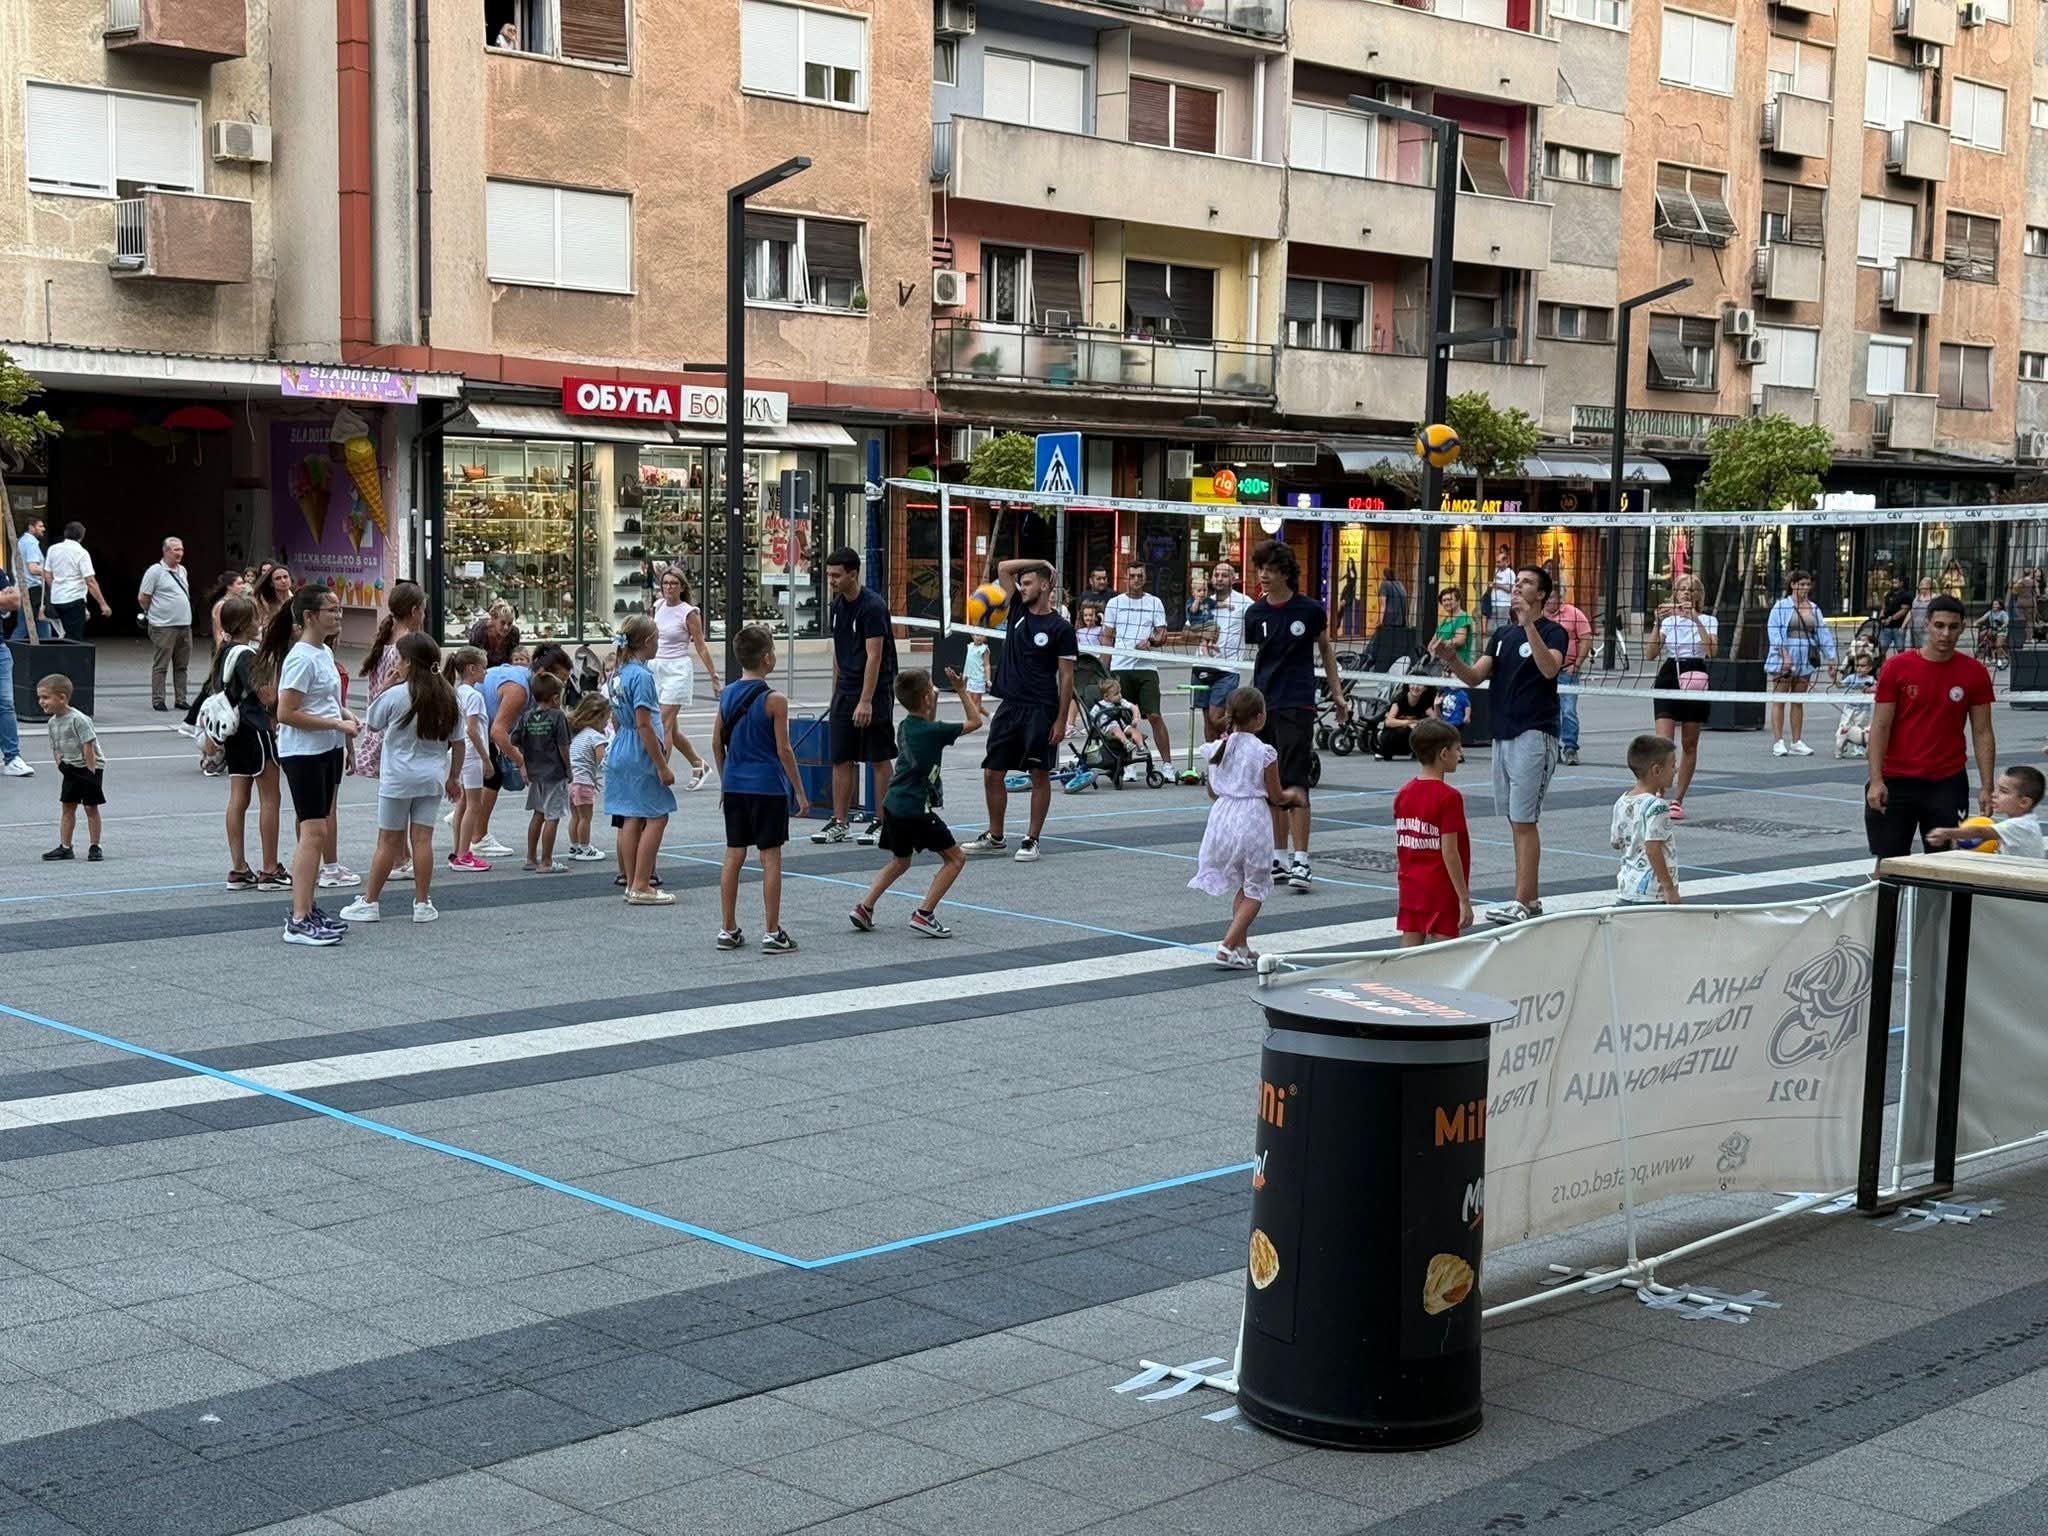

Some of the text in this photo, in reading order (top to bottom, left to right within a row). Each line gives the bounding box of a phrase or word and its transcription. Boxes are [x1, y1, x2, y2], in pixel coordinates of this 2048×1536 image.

[309, 366, 391, 383] SLADOLED
[577, 383, 673, 415] ОБУЋА
[1215, 475, 1232, 490] ria
[1452, 499, 1502, 513] MOZART
[1740, 514, 1755, 522] CEV
[1812, 513, 1828, 521] CEV
[1887, 512, 1903, 520] CEV
[1965, 509, 1982, 518] CEV
[1261, 621, 1267, 637] 1
[1495, 640, 1503, 657] 1
